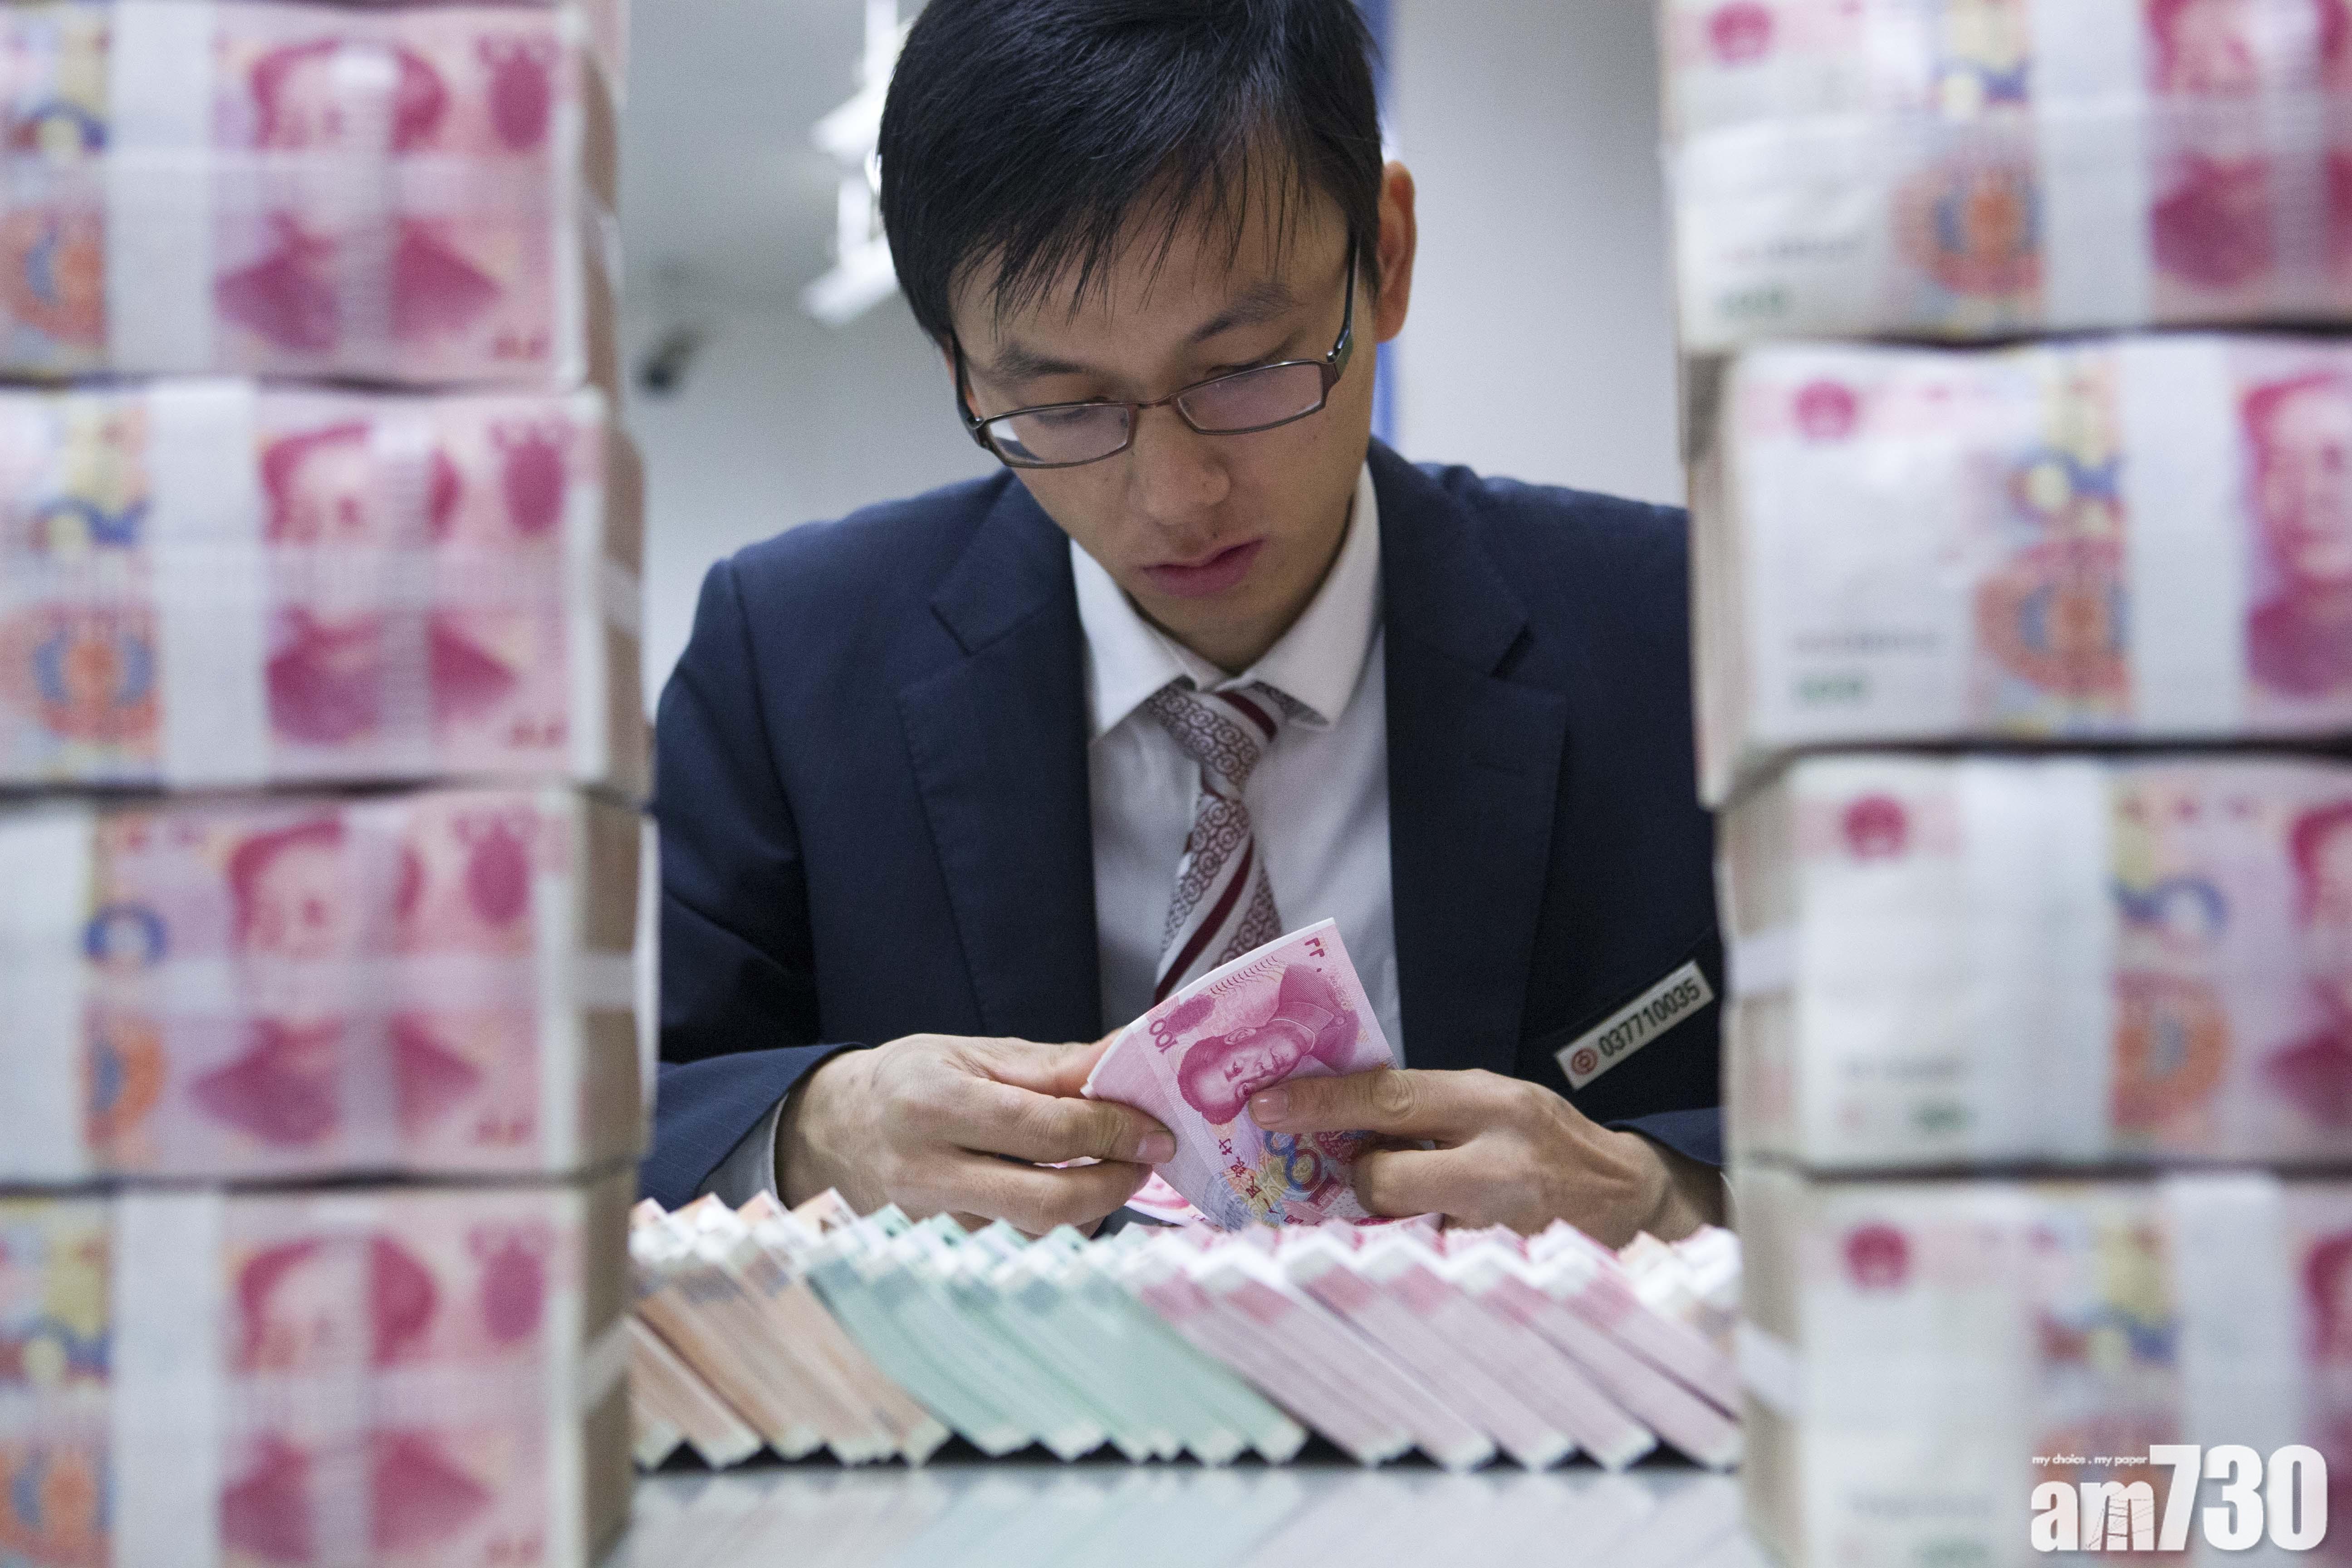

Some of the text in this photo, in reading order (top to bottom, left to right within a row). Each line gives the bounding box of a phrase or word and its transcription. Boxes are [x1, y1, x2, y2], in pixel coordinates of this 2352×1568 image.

[1150, 1018, 1178, 1055] 100
[1599, 977, 1700, 1058] 037710035
[1218, 1138, 1323, 1225] 国人民银行
